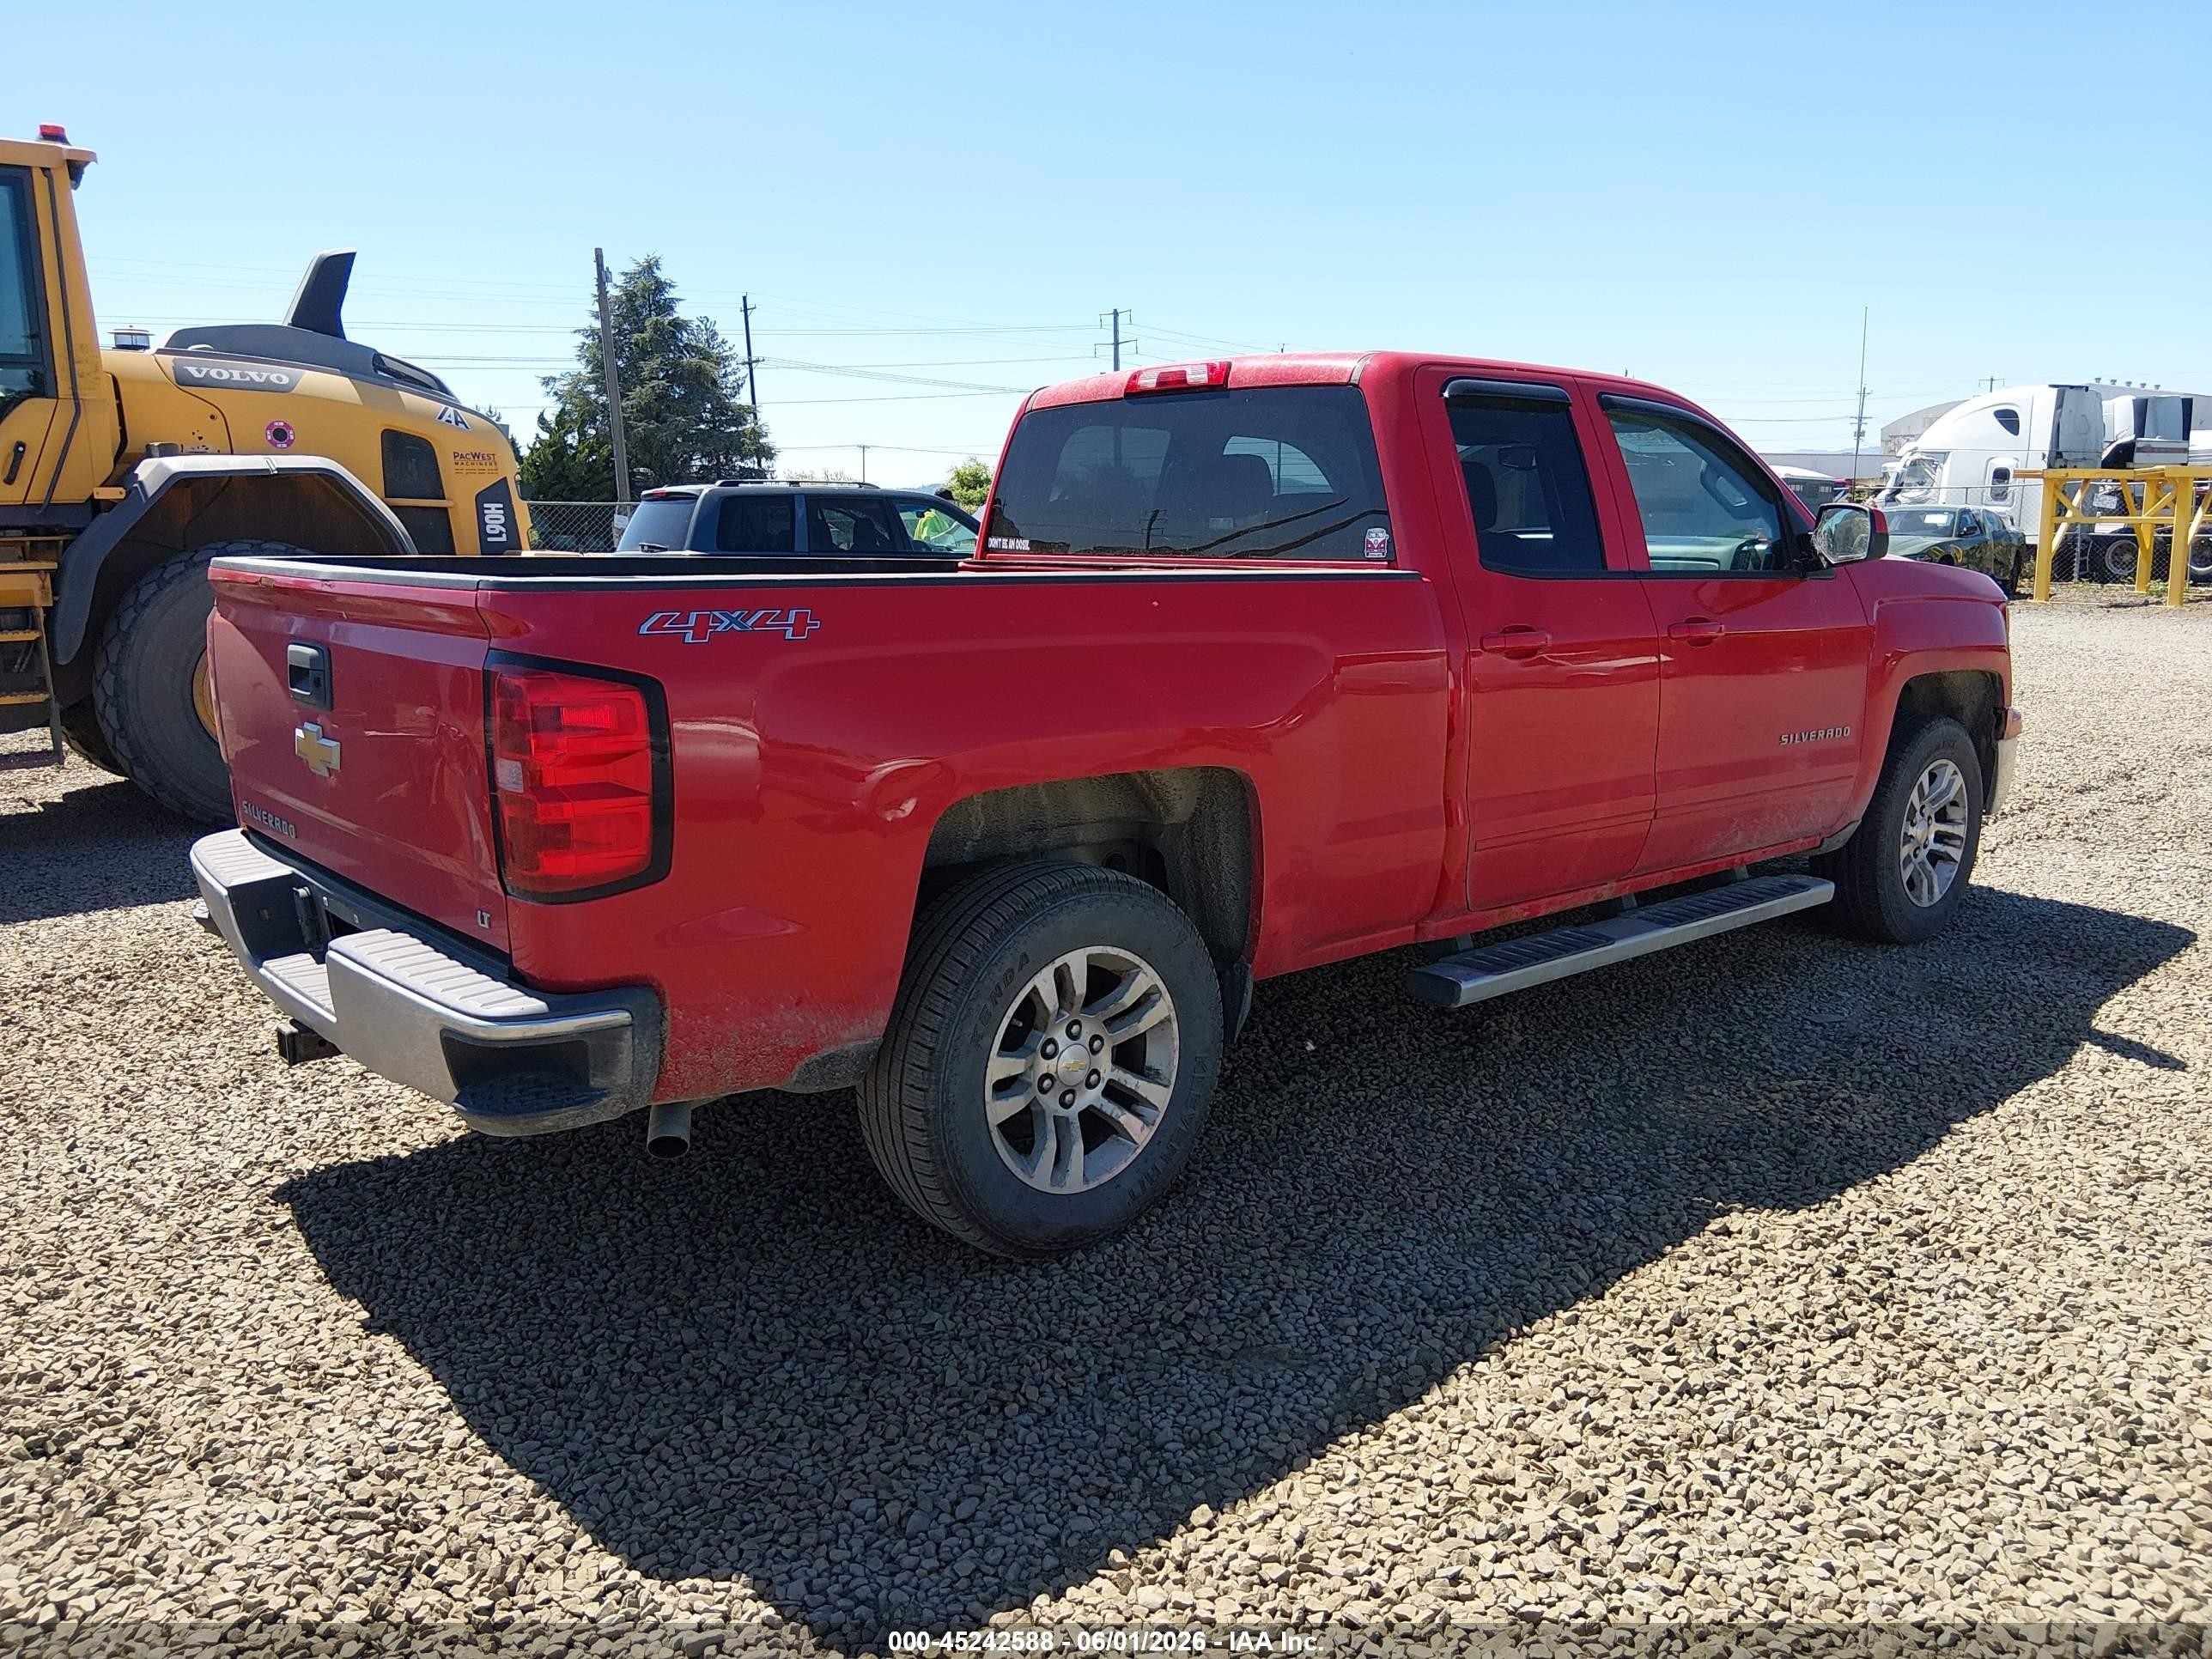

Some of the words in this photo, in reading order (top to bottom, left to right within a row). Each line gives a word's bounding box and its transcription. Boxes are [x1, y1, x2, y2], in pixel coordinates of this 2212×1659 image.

[183, 366, 289, 385] VOLVO
[483, 503, 507, 542] L90H
[1780, 726, 1850, 745] SILVERADO
[242, 800, 297, 838] SILVERADO
[477, 910, 490, 929] LT
[970, 951, 1030, 1051] KENDA
